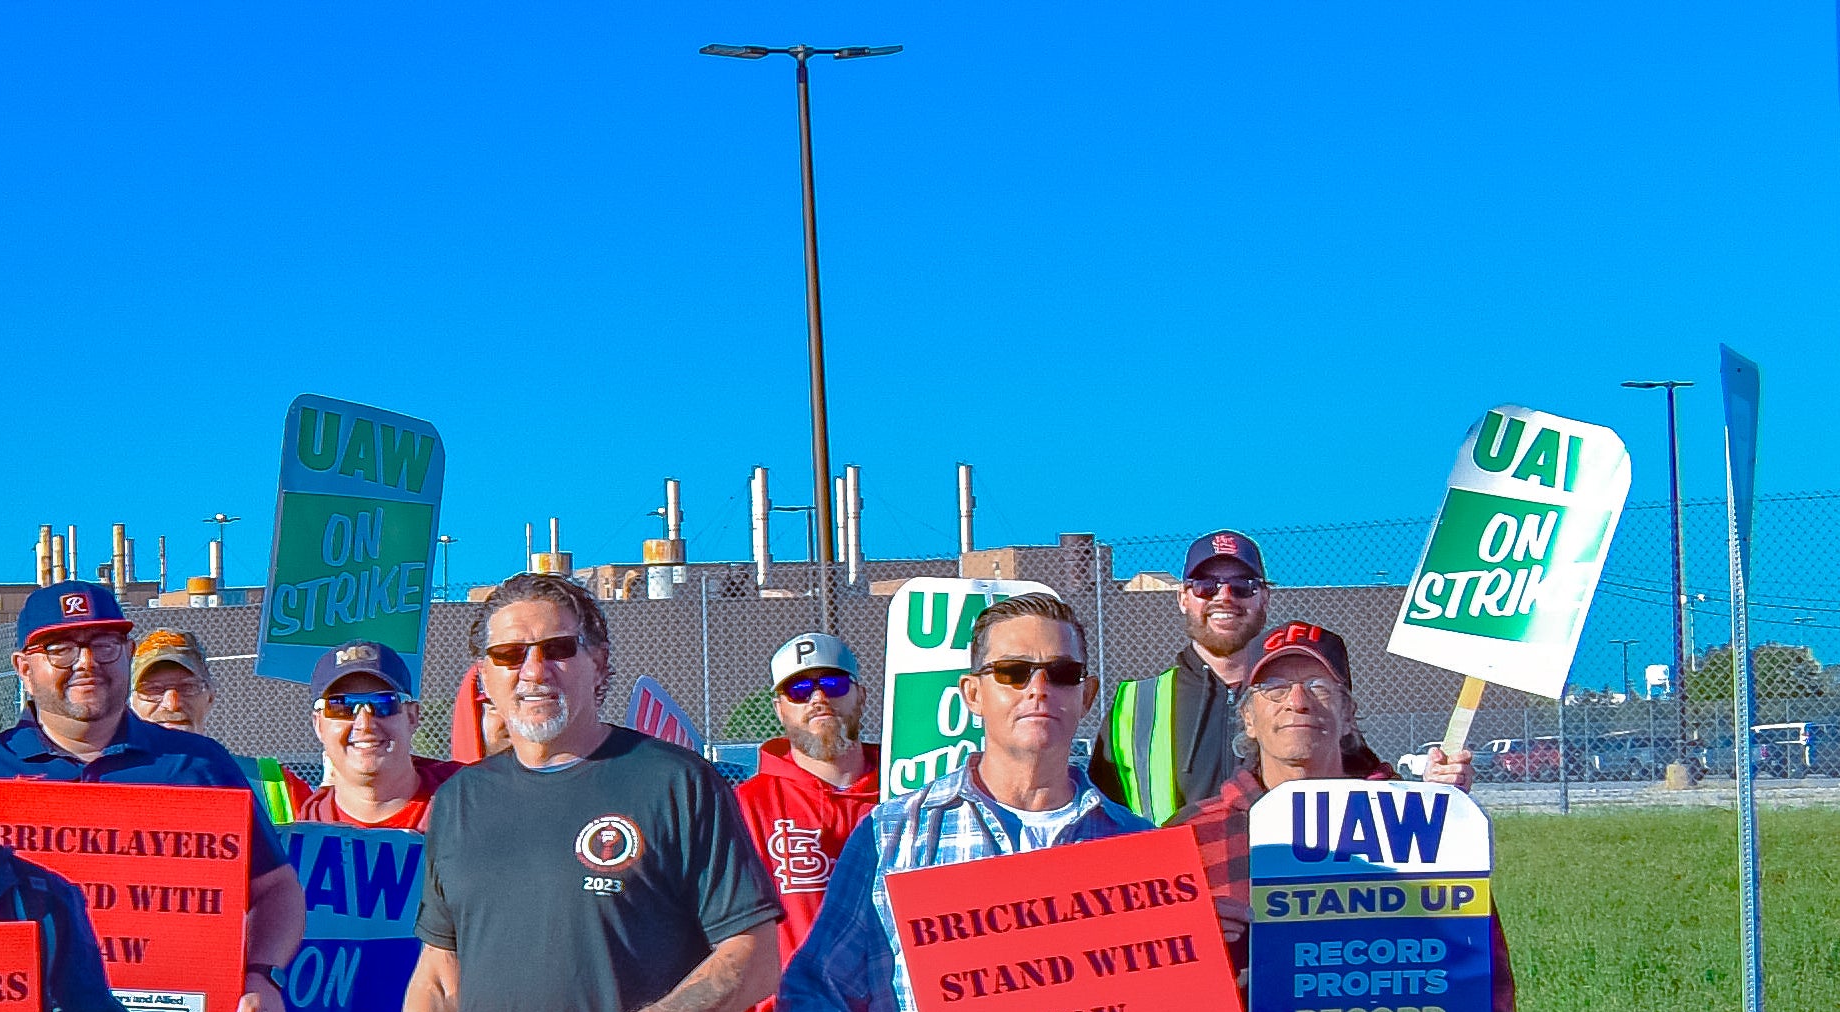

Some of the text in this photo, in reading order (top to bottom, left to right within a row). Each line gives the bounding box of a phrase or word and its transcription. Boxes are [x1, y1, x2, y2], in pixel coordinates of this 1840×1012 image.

[297, 407, 435, 494] UAW
[322, 507, 384, 567] ON
[1479, 511, 1558, 562] ON
[66, 597, 87, 613] R
[271, 562, 426, 636] STRIKE
[796, 641, 816, 664] P
[1291, 791, 1448, 865] UAW
[127, 885, 222, 915] WITH
[583, 877, 621, 893] 2023
[908, 873, 1199, 948] BRICKLAYERS
[1266, 884, 1476, 918] STAND UP
[288, 946, 362, 1008] ON
[940, 935, 1199, 1003] STAND WITH
[1294, 937, 1447, 968] RECORD
[1294, 970, 1448, 998] PROFITS
